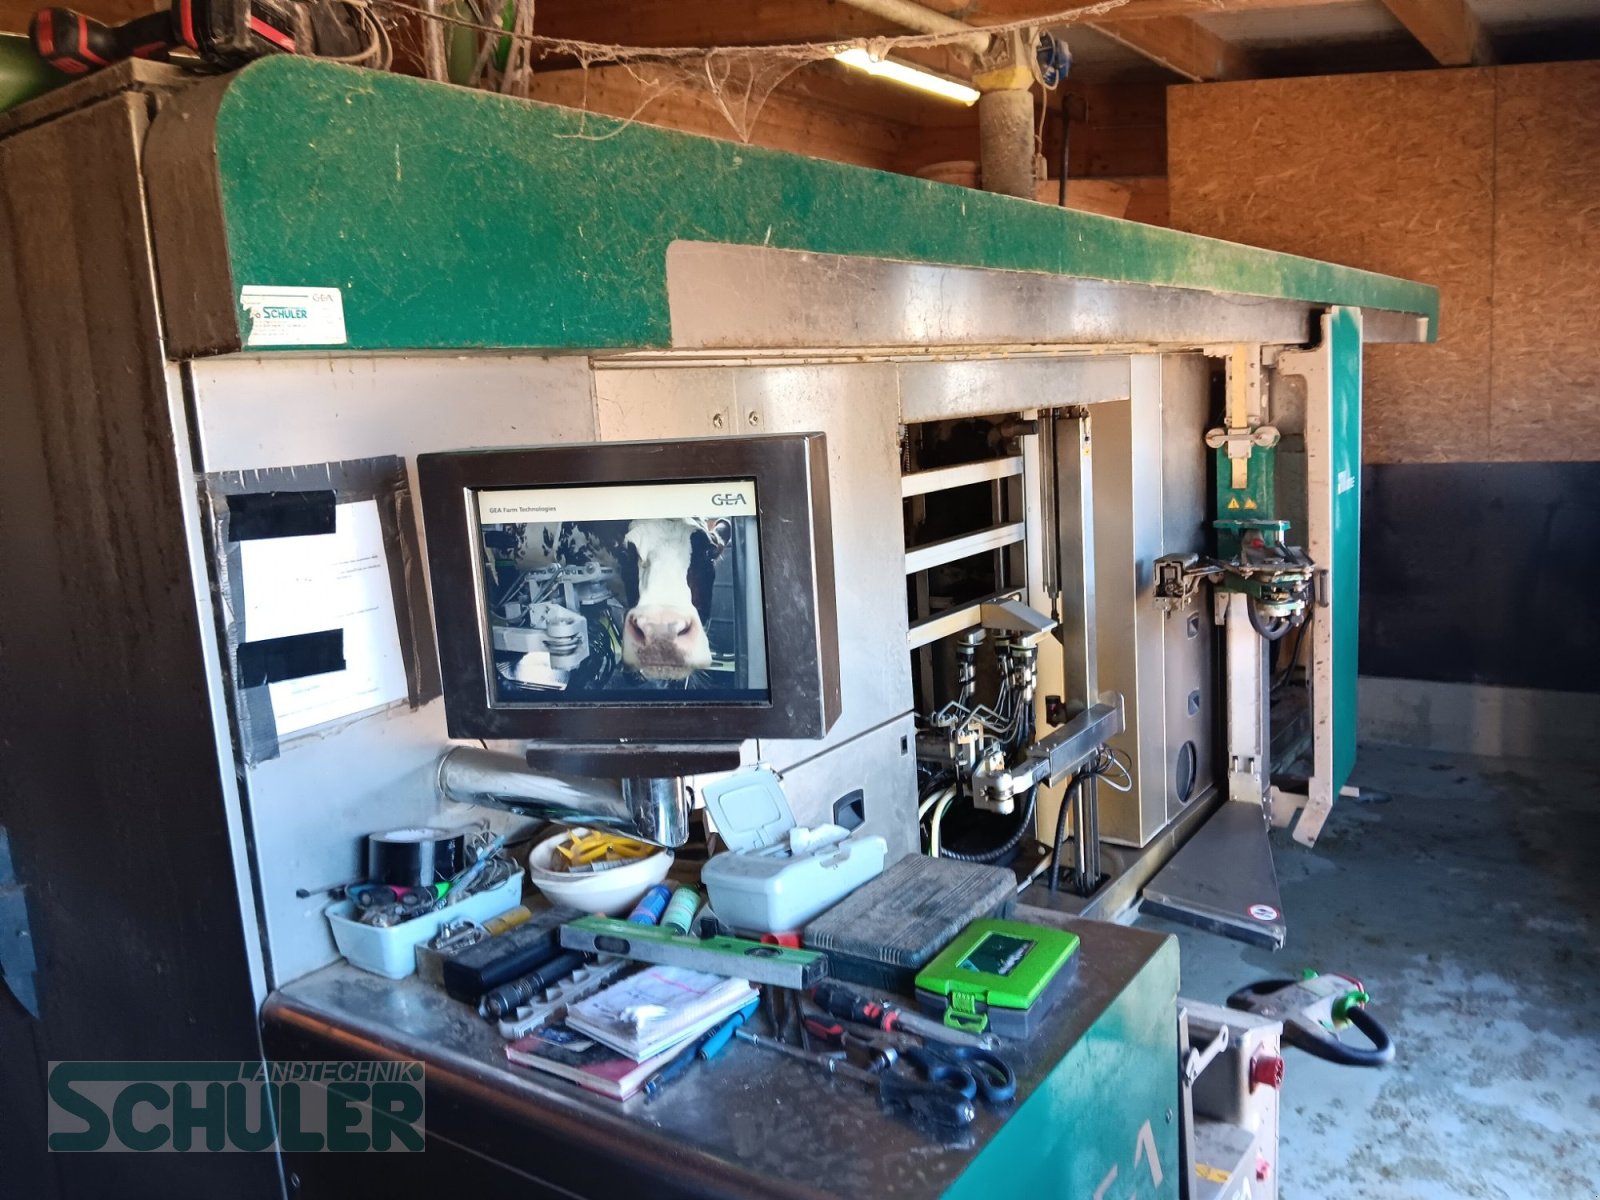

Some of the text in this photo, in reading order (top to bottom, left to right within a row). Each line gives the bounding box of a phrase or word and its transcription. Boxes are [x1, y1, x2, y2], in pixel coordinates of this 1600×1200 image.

[312, 293, 334, 302] GEA
[262, 306, 308, 319] SCHULER
[711, 493, 747, 506] GEA
[519, 505, 557, 514] Technologies
